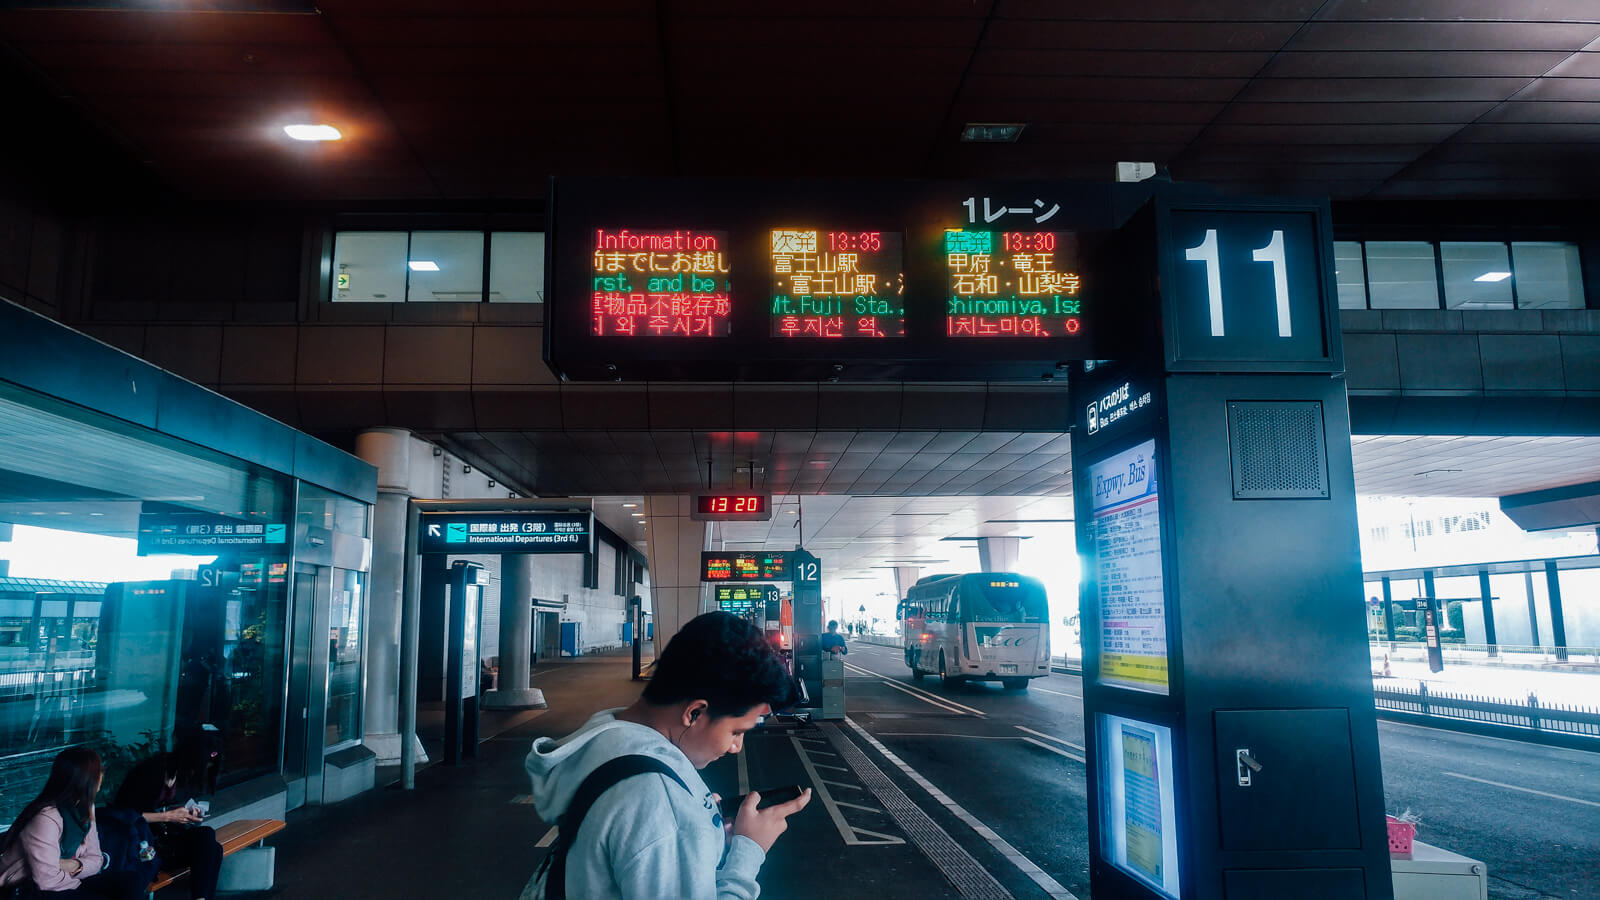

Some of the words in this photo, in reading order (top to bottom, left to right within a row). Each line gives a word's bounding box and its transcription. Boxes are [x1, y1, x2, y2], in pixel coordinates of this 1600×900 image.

[962, 197, 1060, 223] 1レーン
[597, 229, 717, 249] Information
[772, 231, 816, 253] 次発
[828, 232, 880, 251] 13:35
[946, 231, 991, 253] 先発
[1002, 232, 1055, 251] 13:30
[772, 252, 859, 273] 富士山駅
[948, 252, 1056, 273] 甲府・竜王
[647, 273, 682, 292] and
[691, 273, 715, 292] be
[1185, 229, 1292, 337] 11
[648, 315, 713, 336] 주시기
[781, 316, 844, 337] 후지산
[1099, 383, 1129, 412] バスのりば
[1096, 474, 1126, 499] Expwy.
[1127, 462, 1146, 487] Bus
[711, 497, 728, 512] 13
[735, 497, 757, 512] 20
[469, 535, 514, 543] International
[515, 535, 553, 545] Departures
[797, 562, 817, 581] 12
[767, 590, 778, 602] 13
